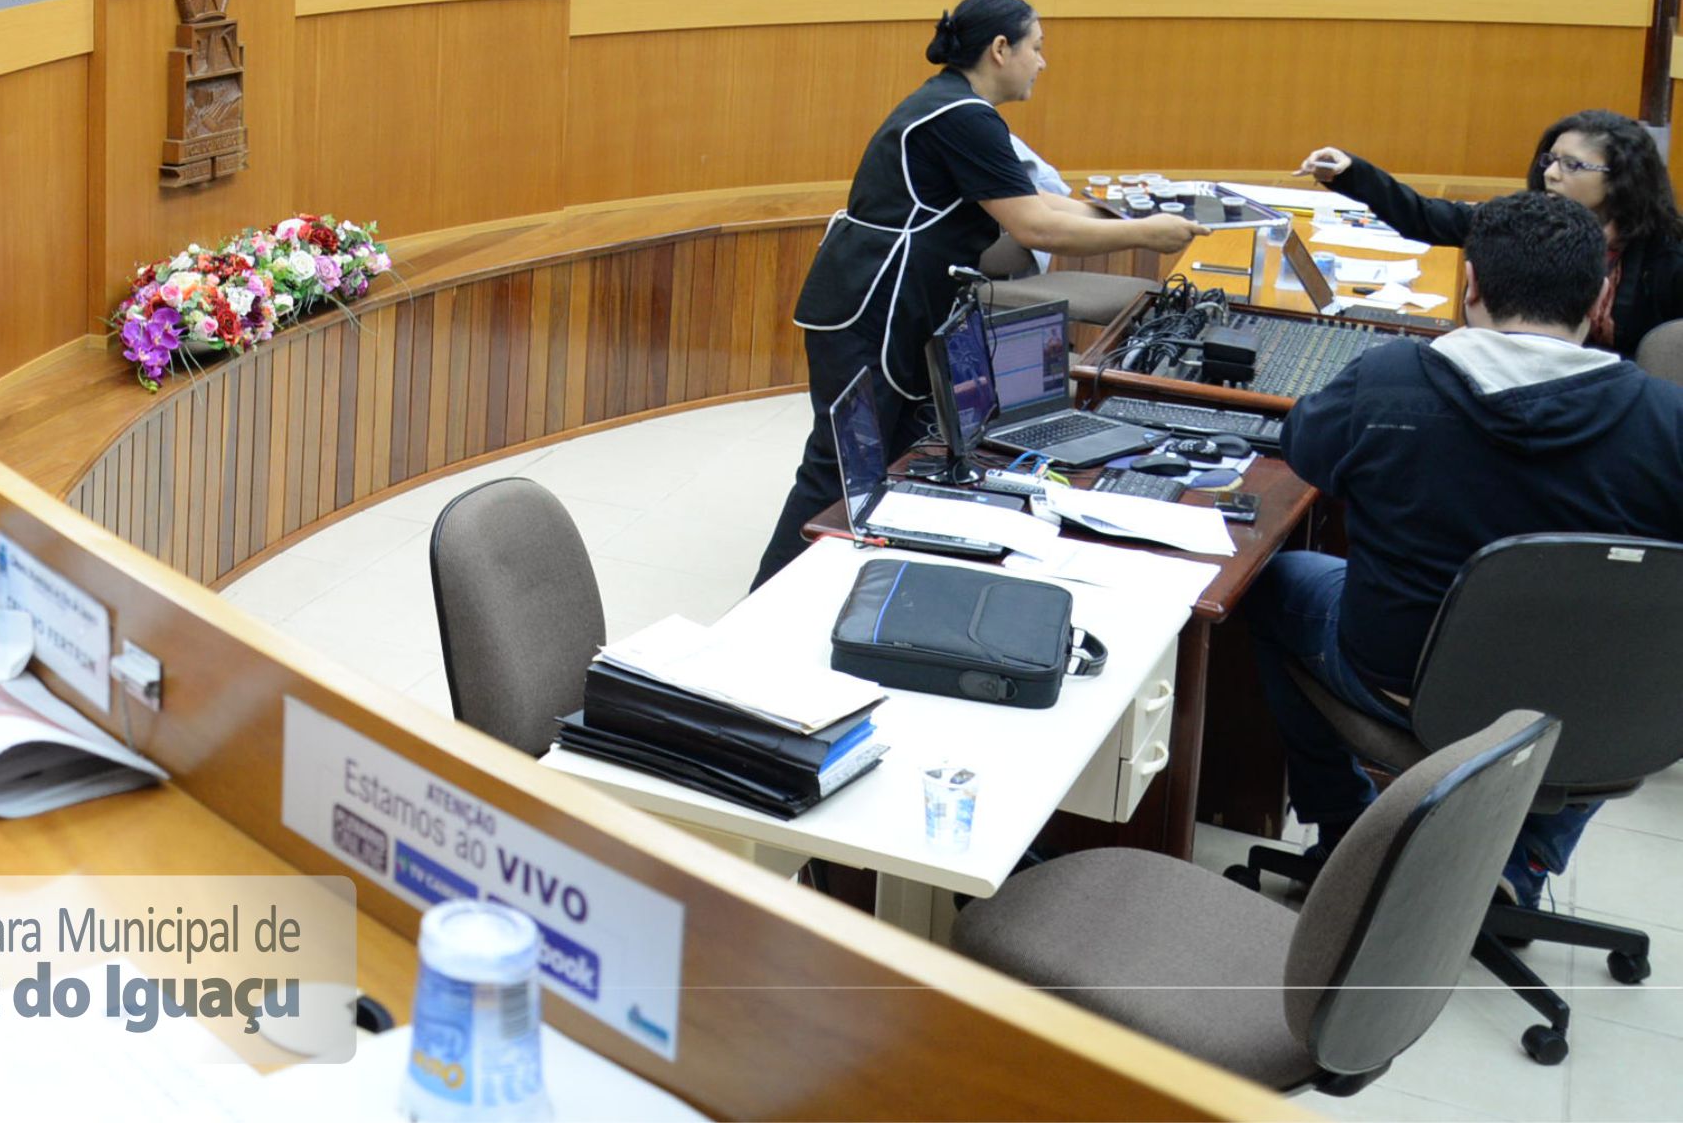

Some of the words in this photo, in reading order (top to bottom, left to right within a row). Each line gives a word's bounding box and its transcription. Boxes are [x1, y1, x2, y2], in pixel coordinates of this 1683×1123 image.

[344, 757, 446, 847] Estamos
[454, 830, 486, 871] ao
[496, 846, 588, 924] VIVO
[426, 782, 497, 837] ATENÇÃO
